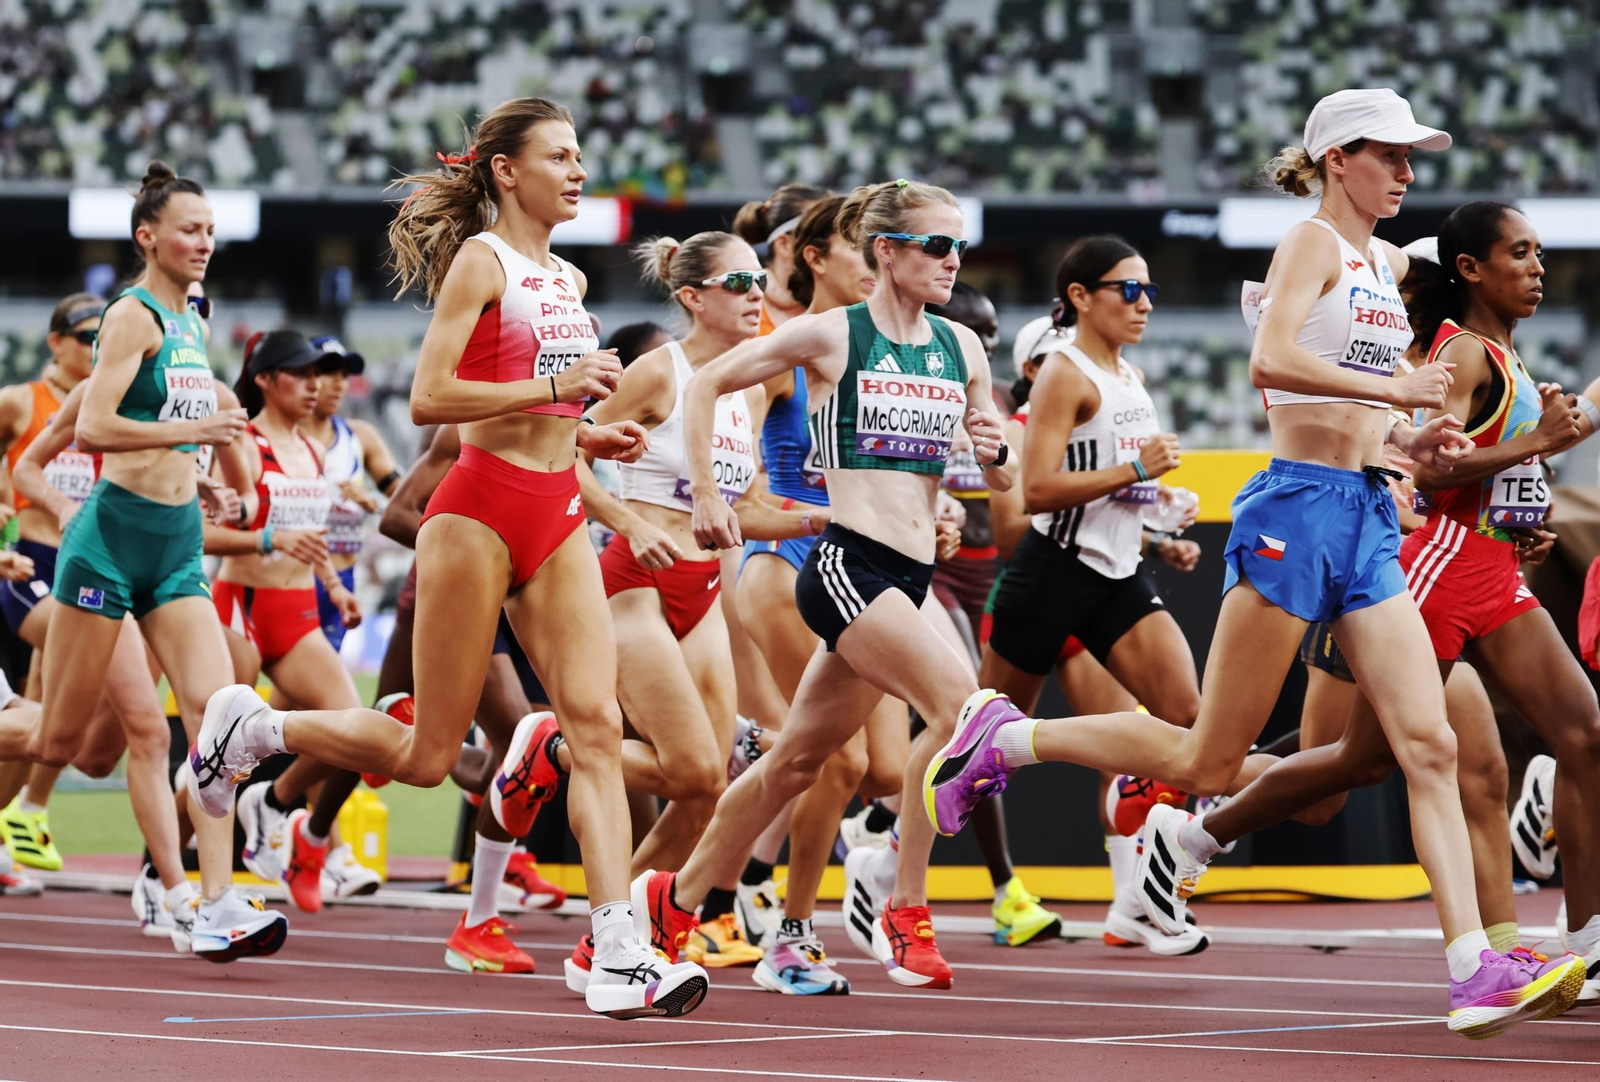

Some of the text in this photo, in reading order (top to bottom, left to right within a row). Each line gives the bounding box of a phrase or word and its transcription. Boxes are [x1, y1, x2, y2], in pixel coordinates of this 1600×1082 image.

[521, 276, 543, 291] 4F
[536, 323, 596, 340] HOND
[169, 376, 214, 389] HOND
[860, 379, 964, 404] HONDA
[170, 399, 214, 419] KLEIN
[862, 406, 960, 438] McCORMACK
[711, 434, 752, 457] ONDA
[712, 460, 753, 488] ODAK
[274, 486, 326, 498] HOND
[1502, 478, 1546, 502] TES
